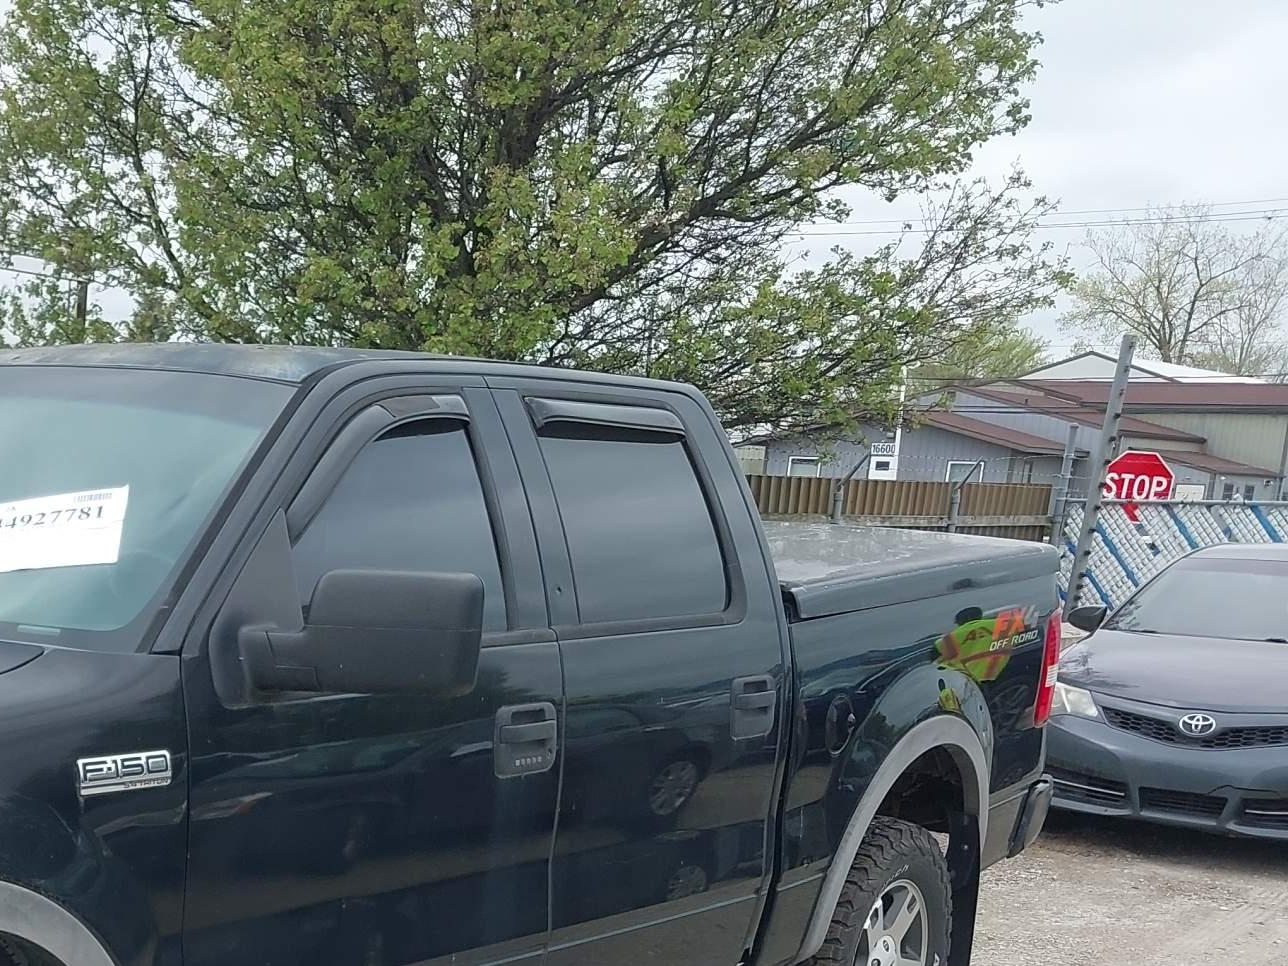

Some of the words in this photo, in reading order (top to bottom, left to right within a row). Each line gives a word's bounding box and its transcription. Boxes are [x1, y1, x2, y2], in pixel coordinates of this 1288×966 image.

[872, 444, 896, 454] 16600
[1102, 472, 1168, 501] STOP
[989, 638, 1009, 652] OFF
[1010, 629, 1039, 646] ROAD
